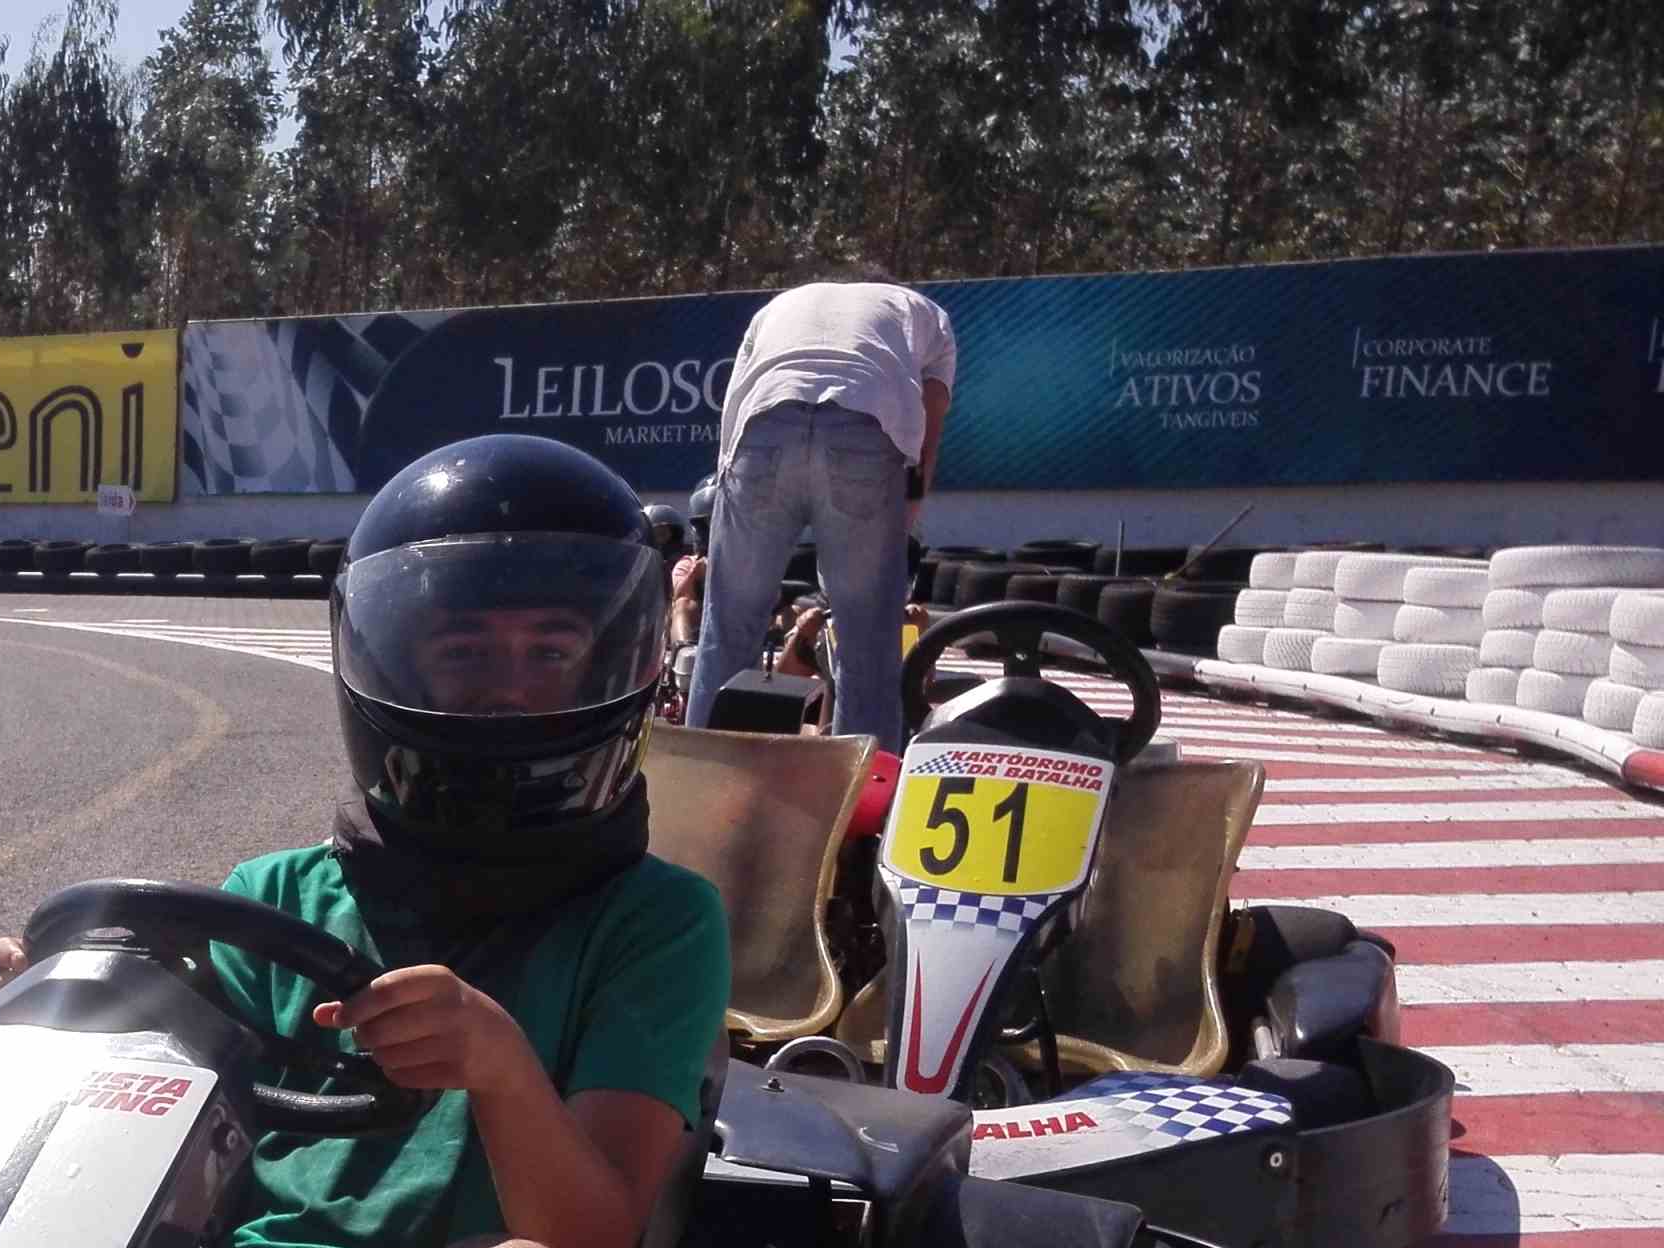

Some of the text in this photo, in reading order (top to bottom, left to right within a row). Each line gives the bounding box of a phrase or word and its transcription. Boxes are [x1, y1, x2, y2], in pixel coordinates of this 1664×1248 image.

[1362, 335, 1493, 357] CORPORATE
[1113, 370, 1262, 409] ATIVOS
[1360, 360, 1553, 399] FINANCE
[604, 424, 686, 445] MARKET
[951, 751, 1103, 778] KARTÓDROMO
[967, 763, 1104, 792] DA BATALHA
[919, 777, 1030, 884] 51
[86, 1071, 193, 1098] ISTA
[70, 1089, 178, 1116] TING
[973, 1111, 1099, 1141] ALHA
